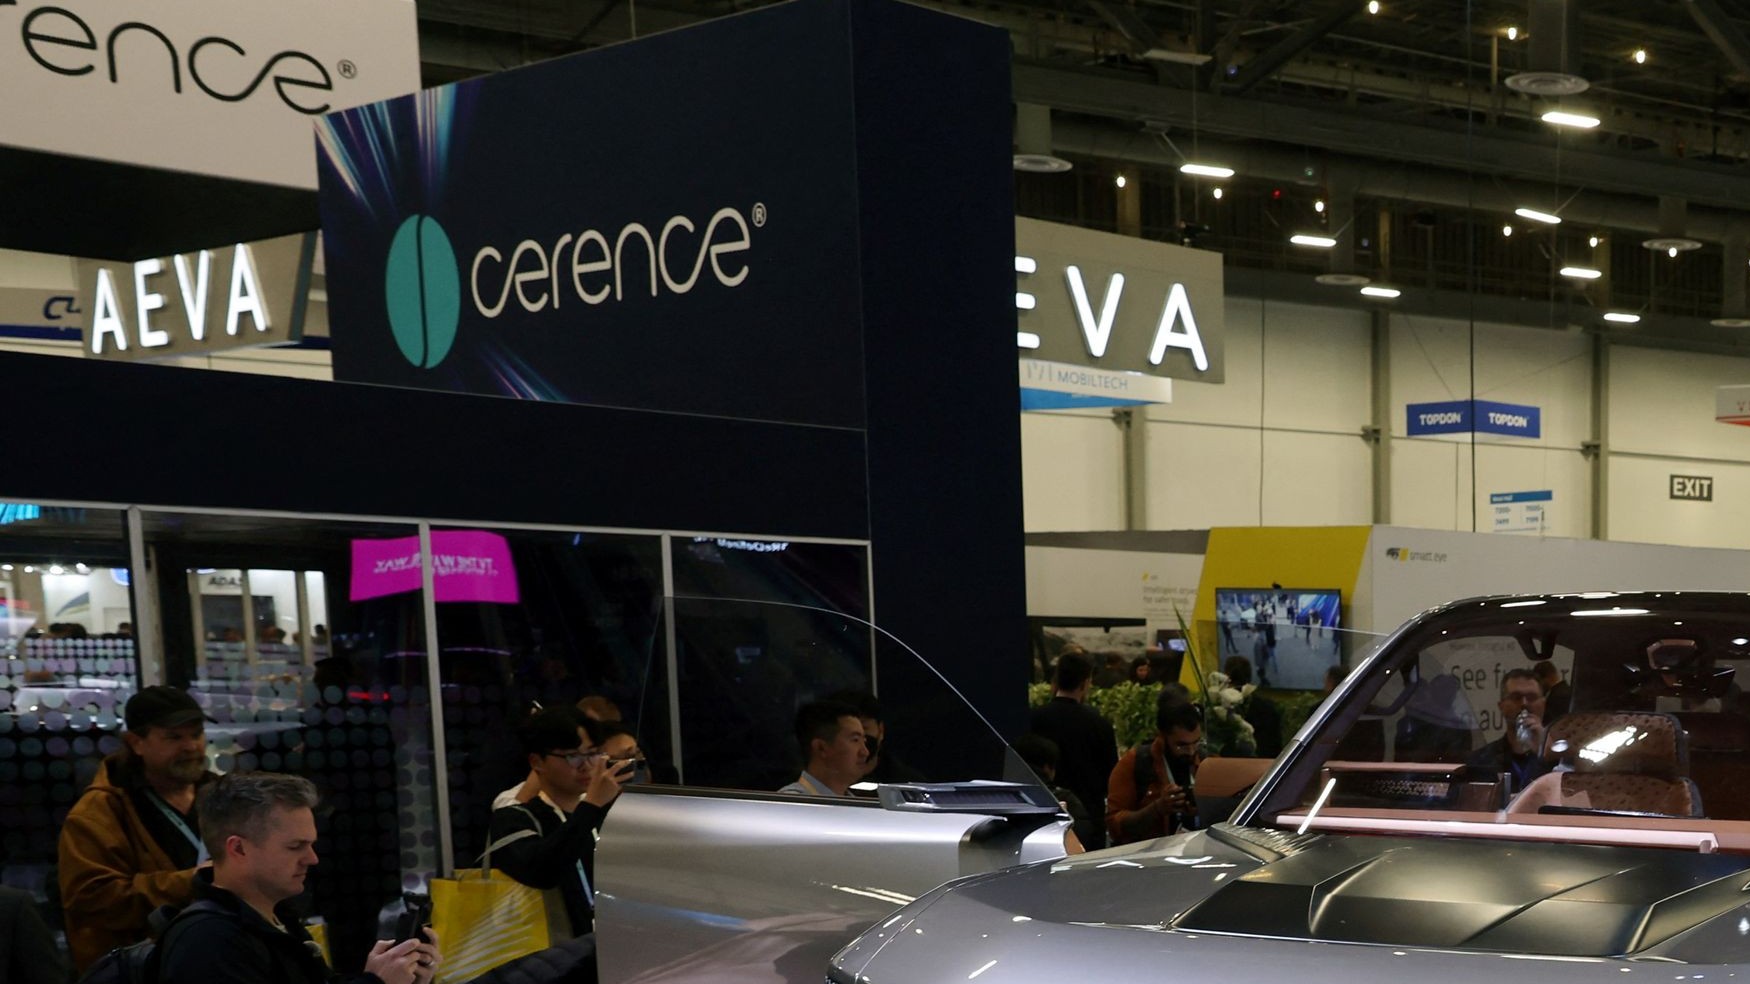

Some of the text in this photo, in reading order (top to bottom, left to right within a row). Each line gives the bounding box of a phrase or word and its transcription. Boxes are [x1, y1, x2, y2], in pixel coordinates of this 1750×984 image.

[91, 242, 267, 354] AEVA
[1057, 370, 1129, 391] MOBILTECH
[1419, 412, 1462, 426] TOPDON
[1488, 412, 1528, 428] TOPDON
[1672, 477, 1712, 498] EXIT
[1451, 664, 1487, 690] See
